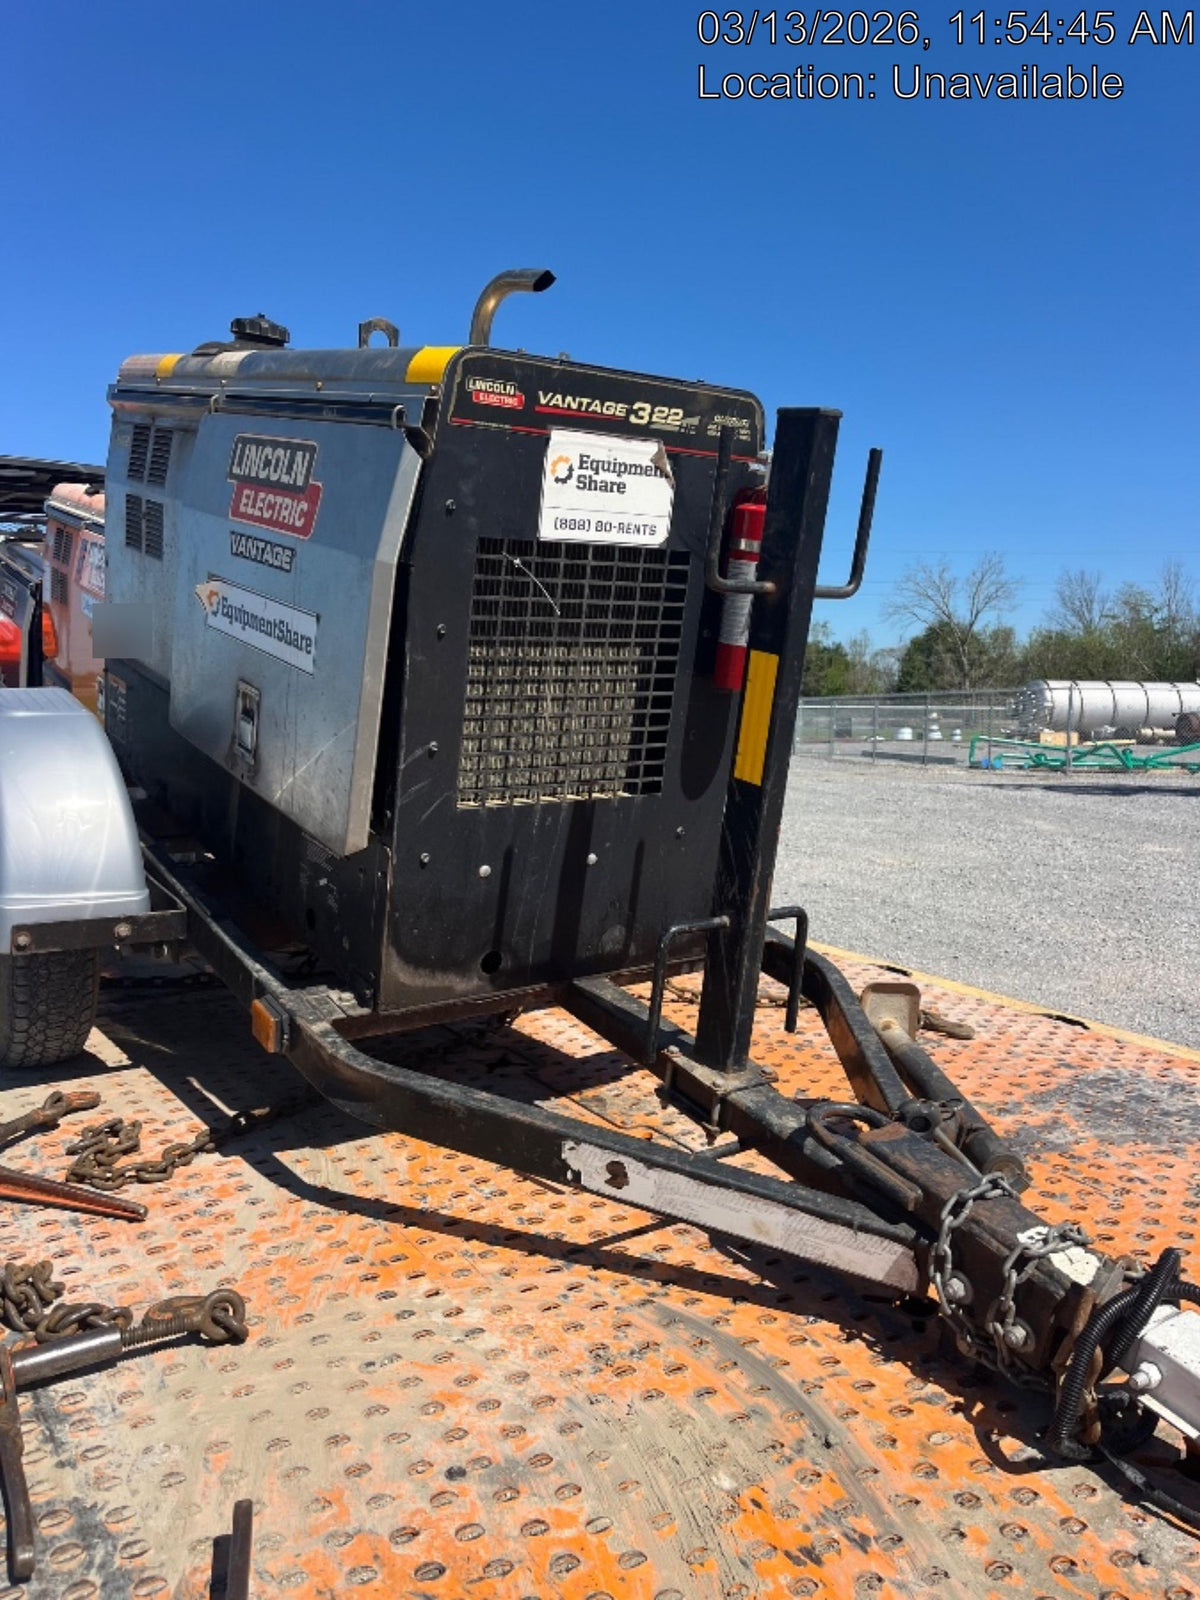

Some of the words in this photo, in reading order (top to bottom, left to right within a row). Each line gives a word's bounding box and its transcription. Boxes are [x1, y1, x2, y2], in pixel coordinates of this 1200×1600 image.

[468, 377, 515, 396] LINCOLN
[479, 392, 518, 406] ELECTRIC
[537, 389, 629, 418] VANTAGE
[629, 401, 685, 425] 322
[231, 442, 310, 487] LINCOLN
[577, 453, 667, 479] Equipmen
[575, 474, 627, 495] Share
[238, 488, 309, 527] ELECTRIC
[554, 516, 591, 533] (888)
[230, 533, 293, 570] VANTAGE
[220, 596, 313, 655] EquipmentShare
